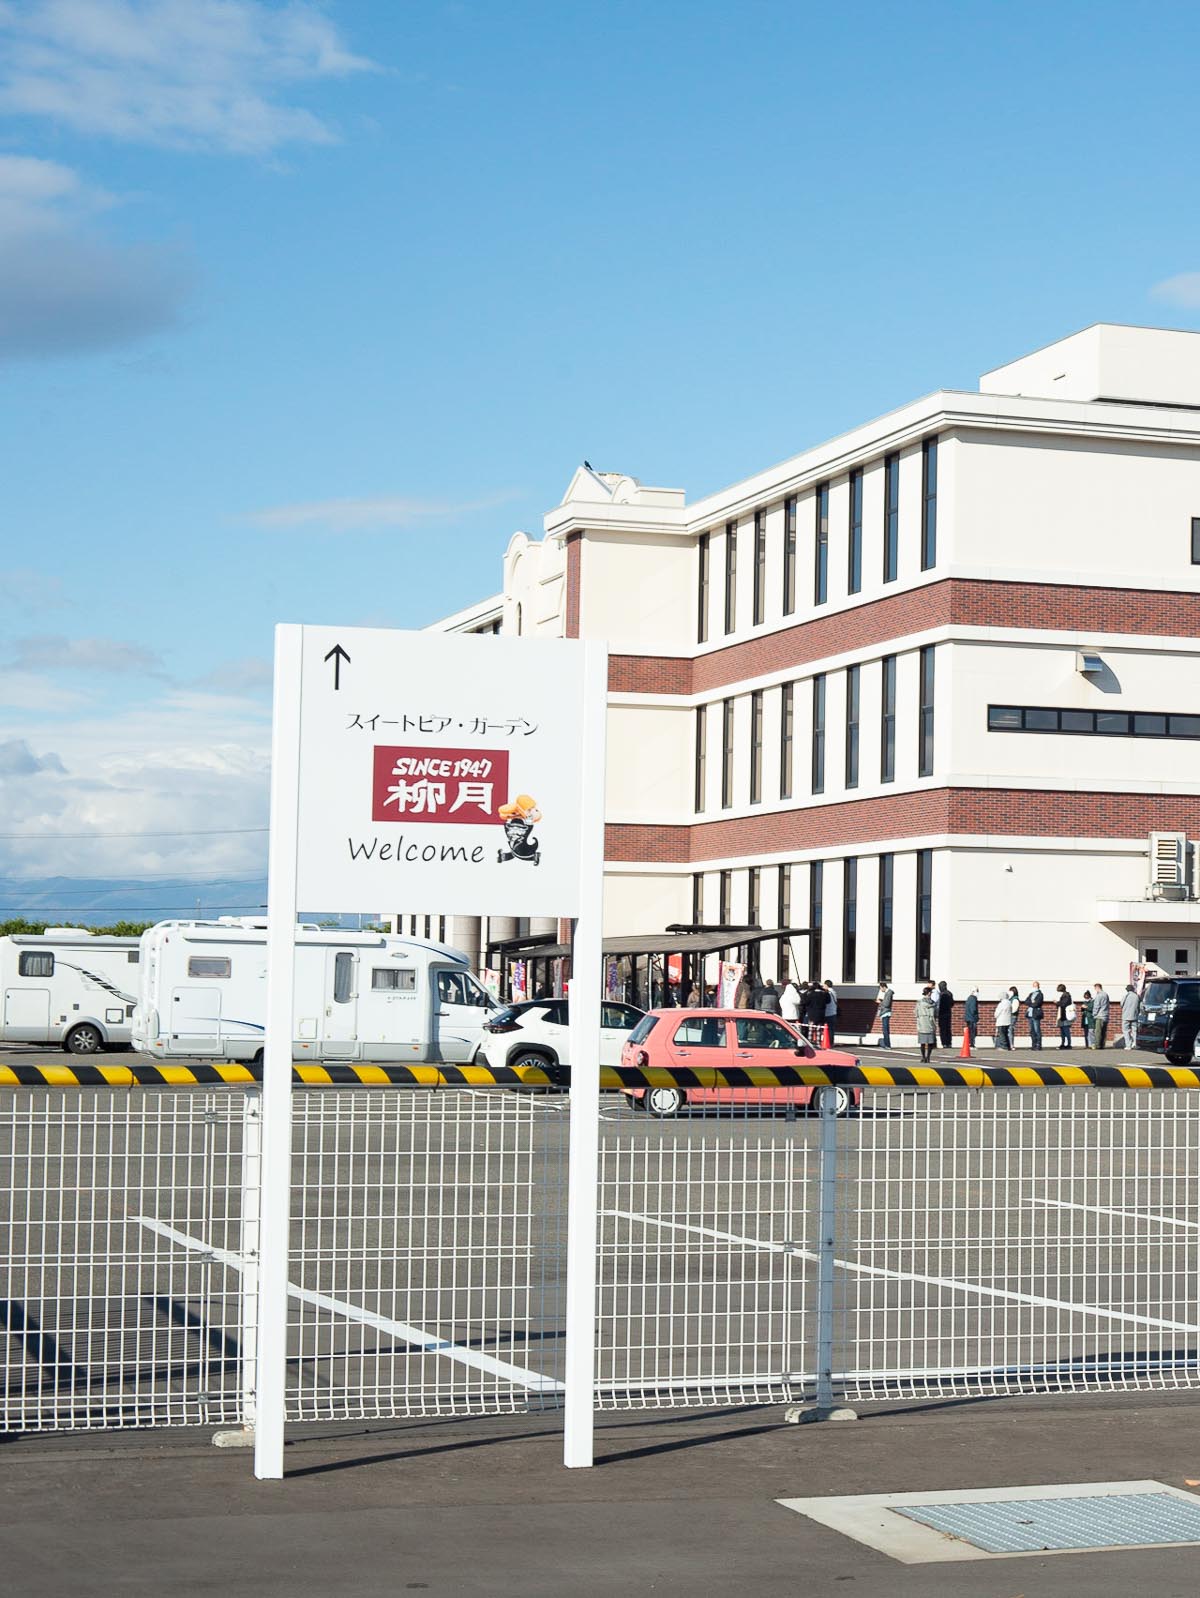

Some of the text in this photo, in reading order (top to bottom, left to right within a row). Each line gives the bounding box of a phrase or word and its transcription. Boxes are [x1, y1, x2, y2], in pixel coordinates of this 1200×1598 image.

[346, 713, 538, 736] スイートピア・ガーデン
[391, 757, 493, 778] SINCE 1947
[383, 778, 494, 815] 柳月
[348, 835, 486, 864] Welcome
